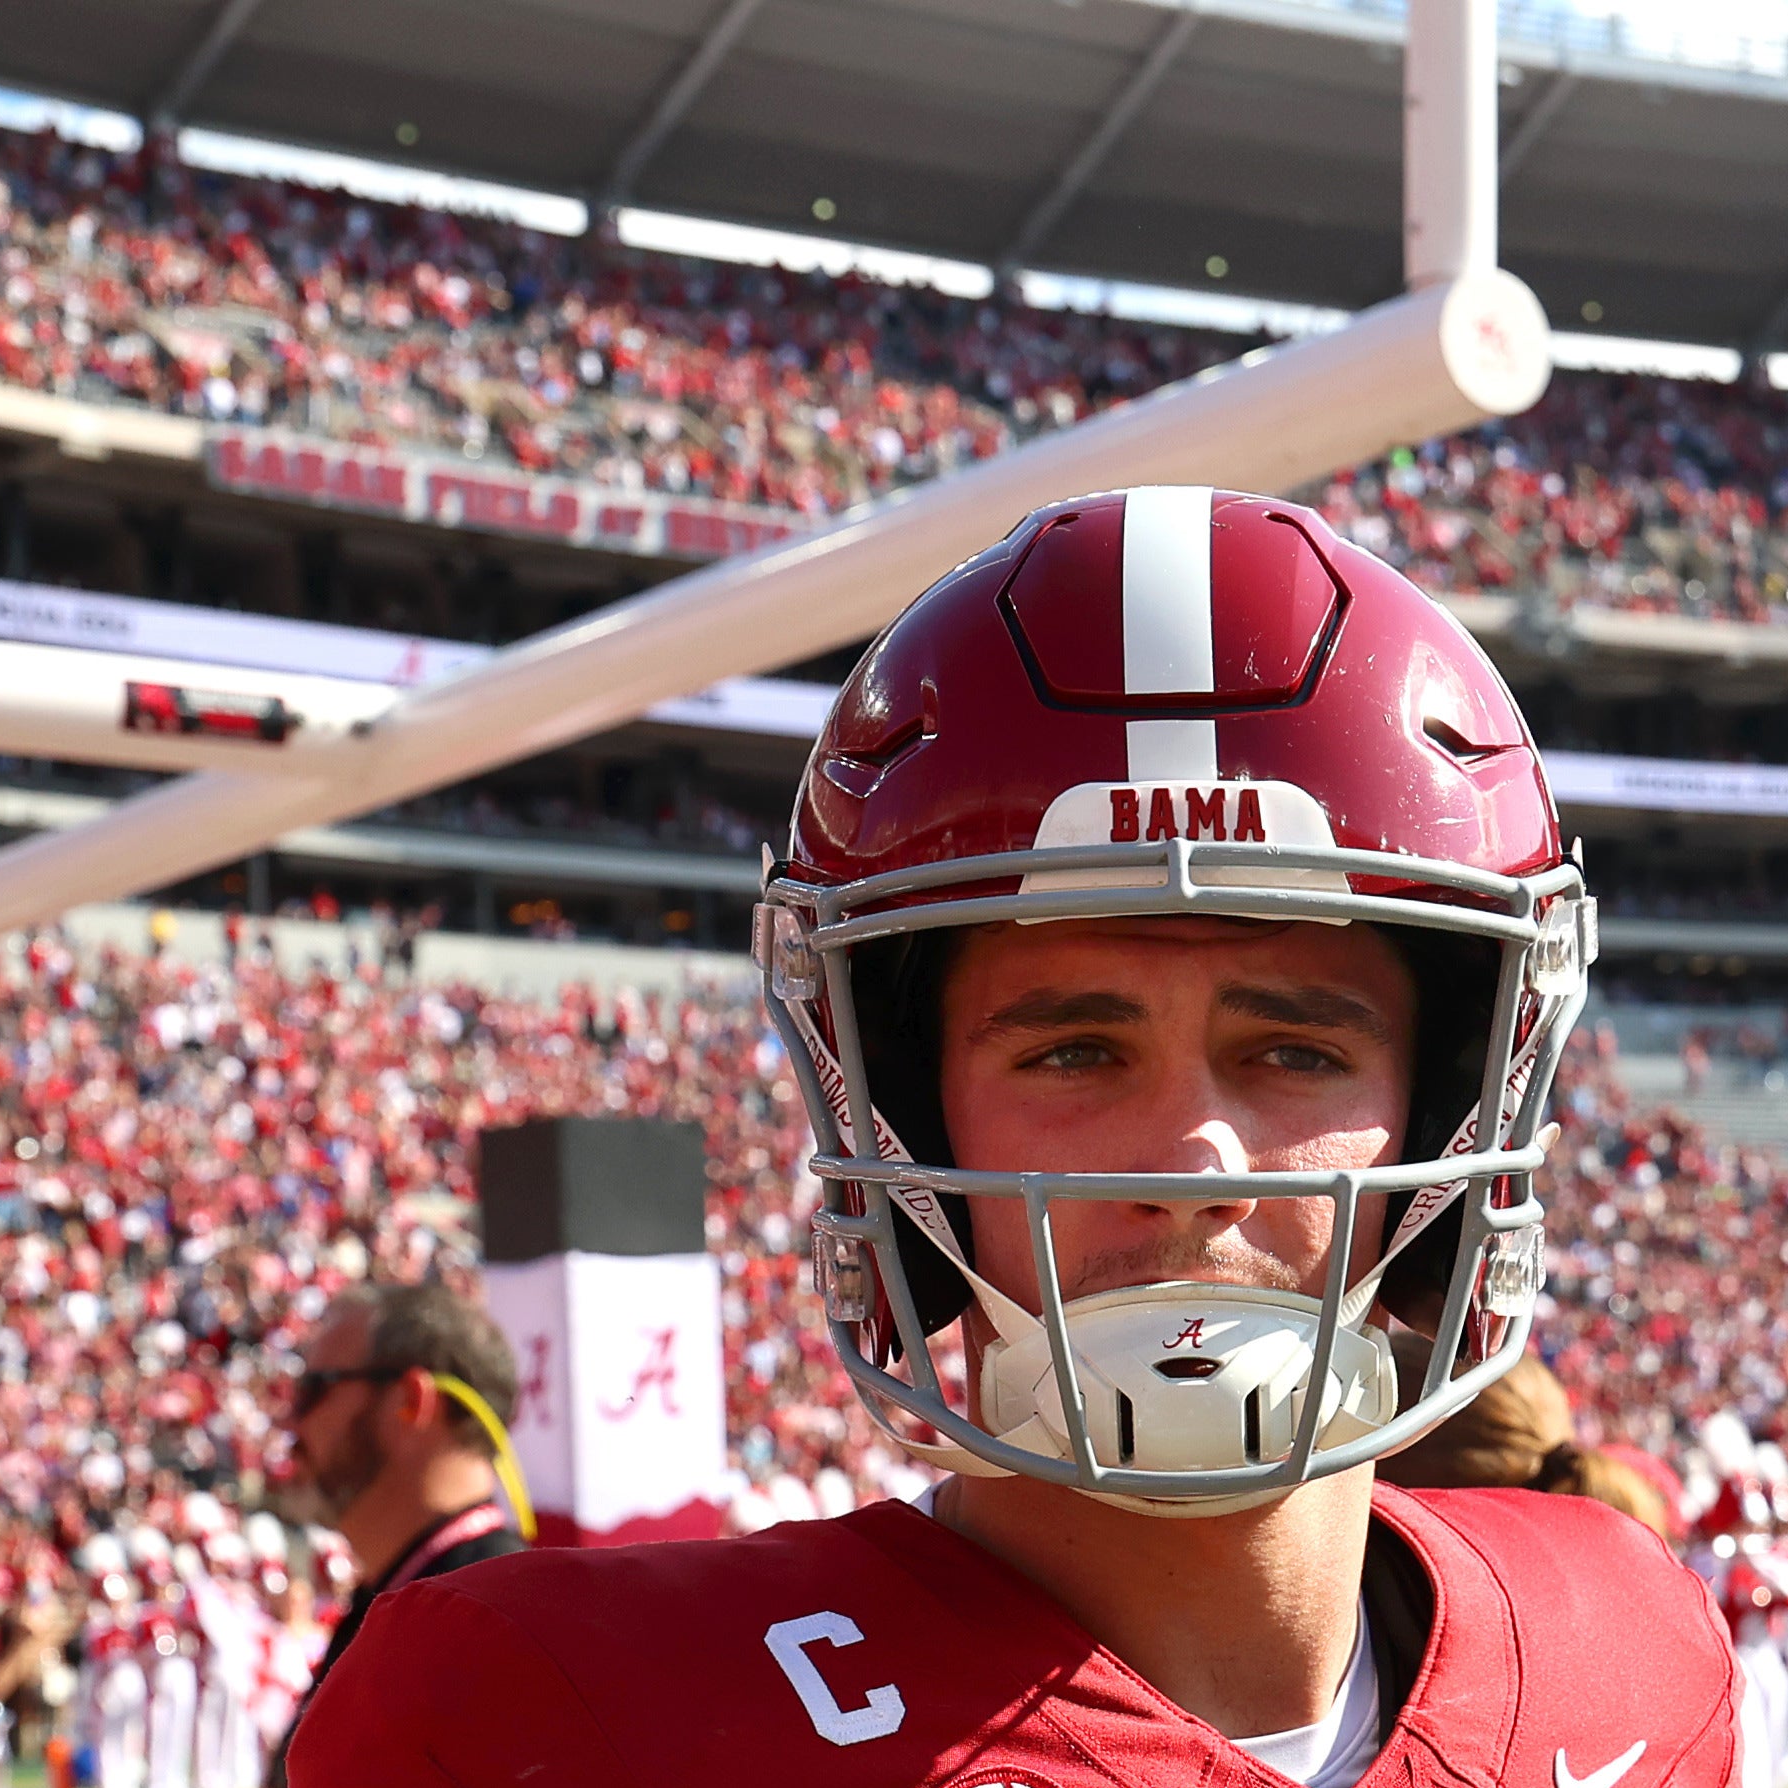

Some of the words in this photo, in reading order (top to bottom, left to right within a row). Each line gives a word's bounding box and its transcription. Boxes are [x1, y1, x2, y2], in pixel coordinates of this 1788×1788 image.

[1109, 788, 1266, 843] BAMA
[1162, 1317, 1204, 1350] A
[595, 1326, 682, 1422] A
[764, 1609, 907, 1746] C
